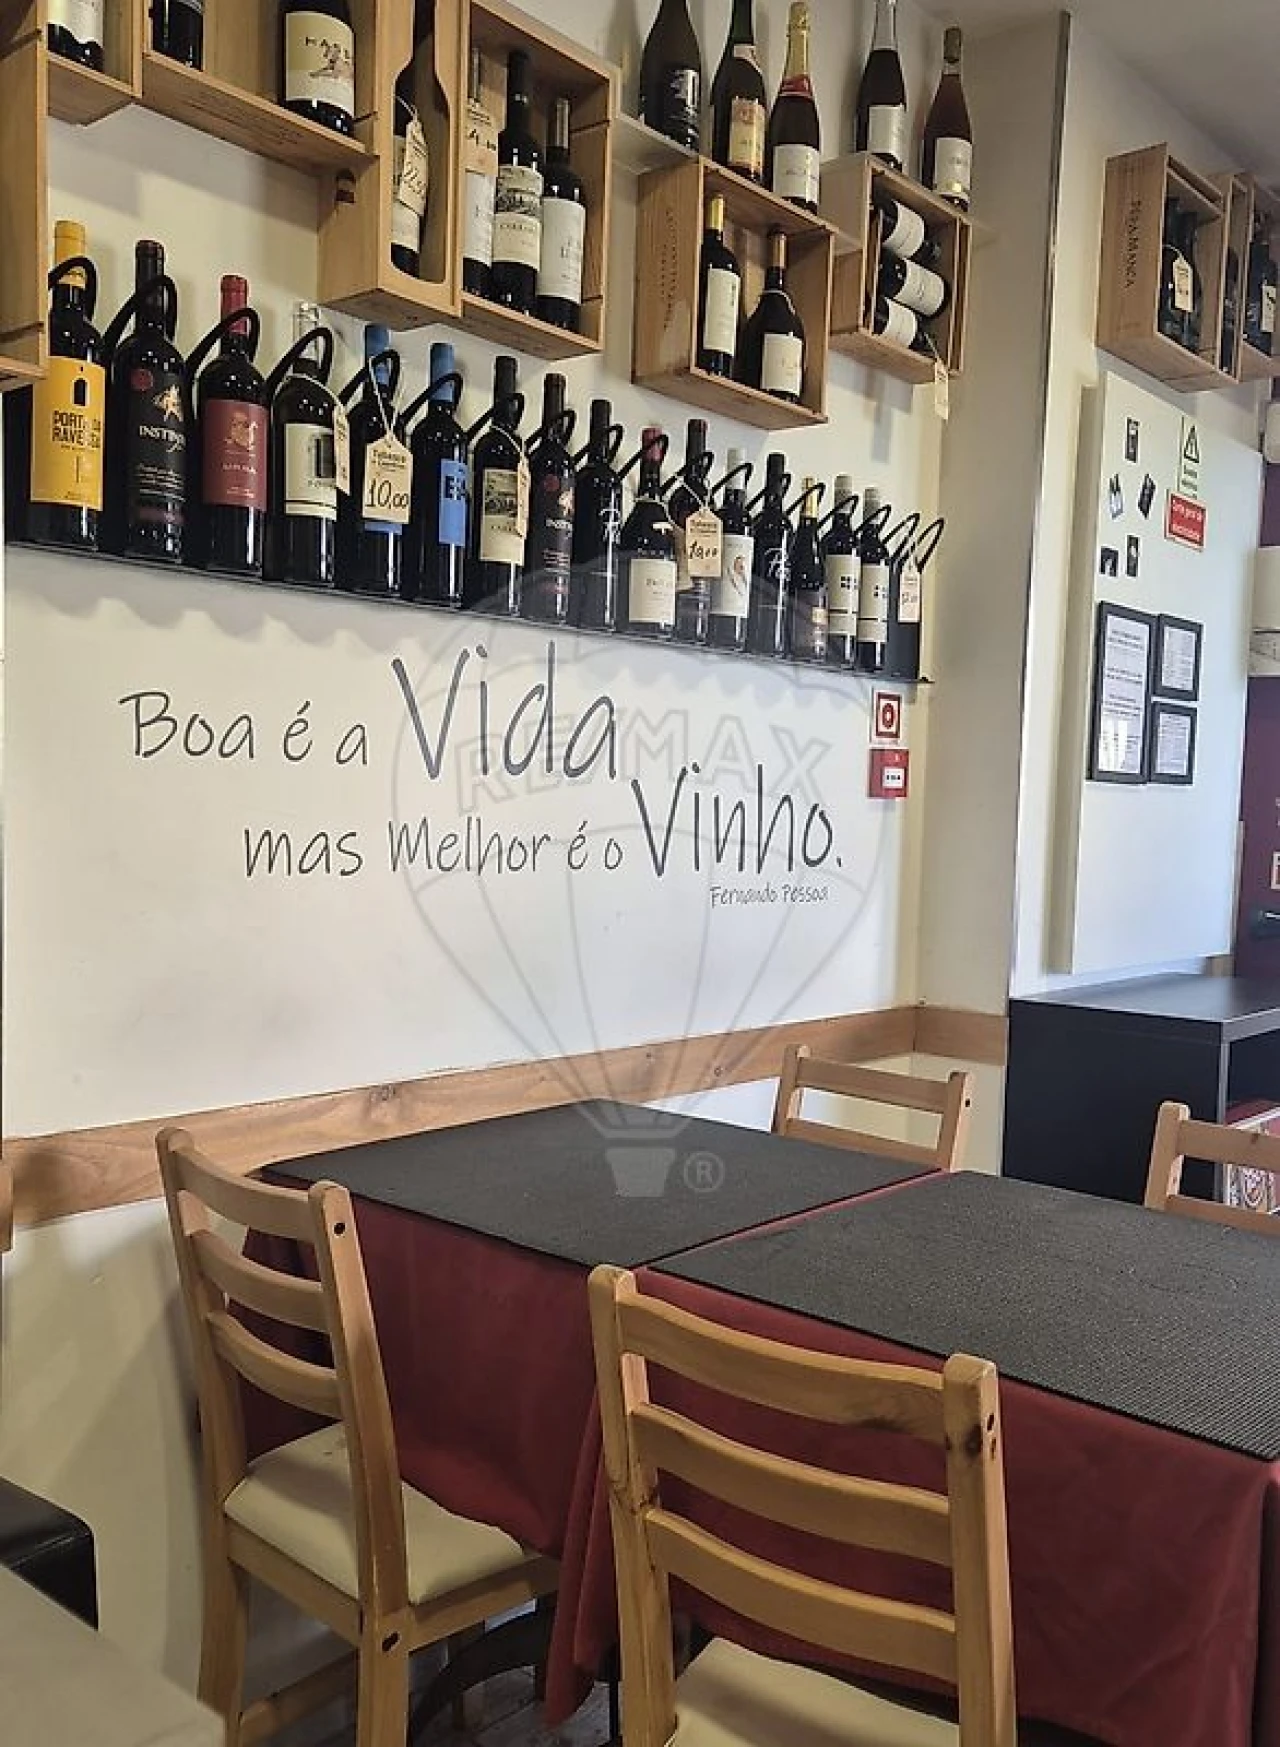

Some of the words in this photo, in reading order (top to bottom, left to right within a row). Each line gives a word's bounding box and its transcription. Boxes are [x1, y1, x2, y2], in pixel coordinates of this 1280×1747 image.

[364, 479, 409, 509] 10,00
[119, 690, 254, 760] Boa
[282, 700, 314, 763] é
[335, 724, 368, 766] a
[391, 640, 617, 780] Vida
[244, 817, 364, 878] mas
[388, 816, 550, 876] Melhor
[566, 820, 589, 871] é
[604, 836, 624, 871] o
[630, 762, 842, 877] Vinho.
[710, 881, 778, 908] Fernando
[781, 883, 829, 903] Pessoa
